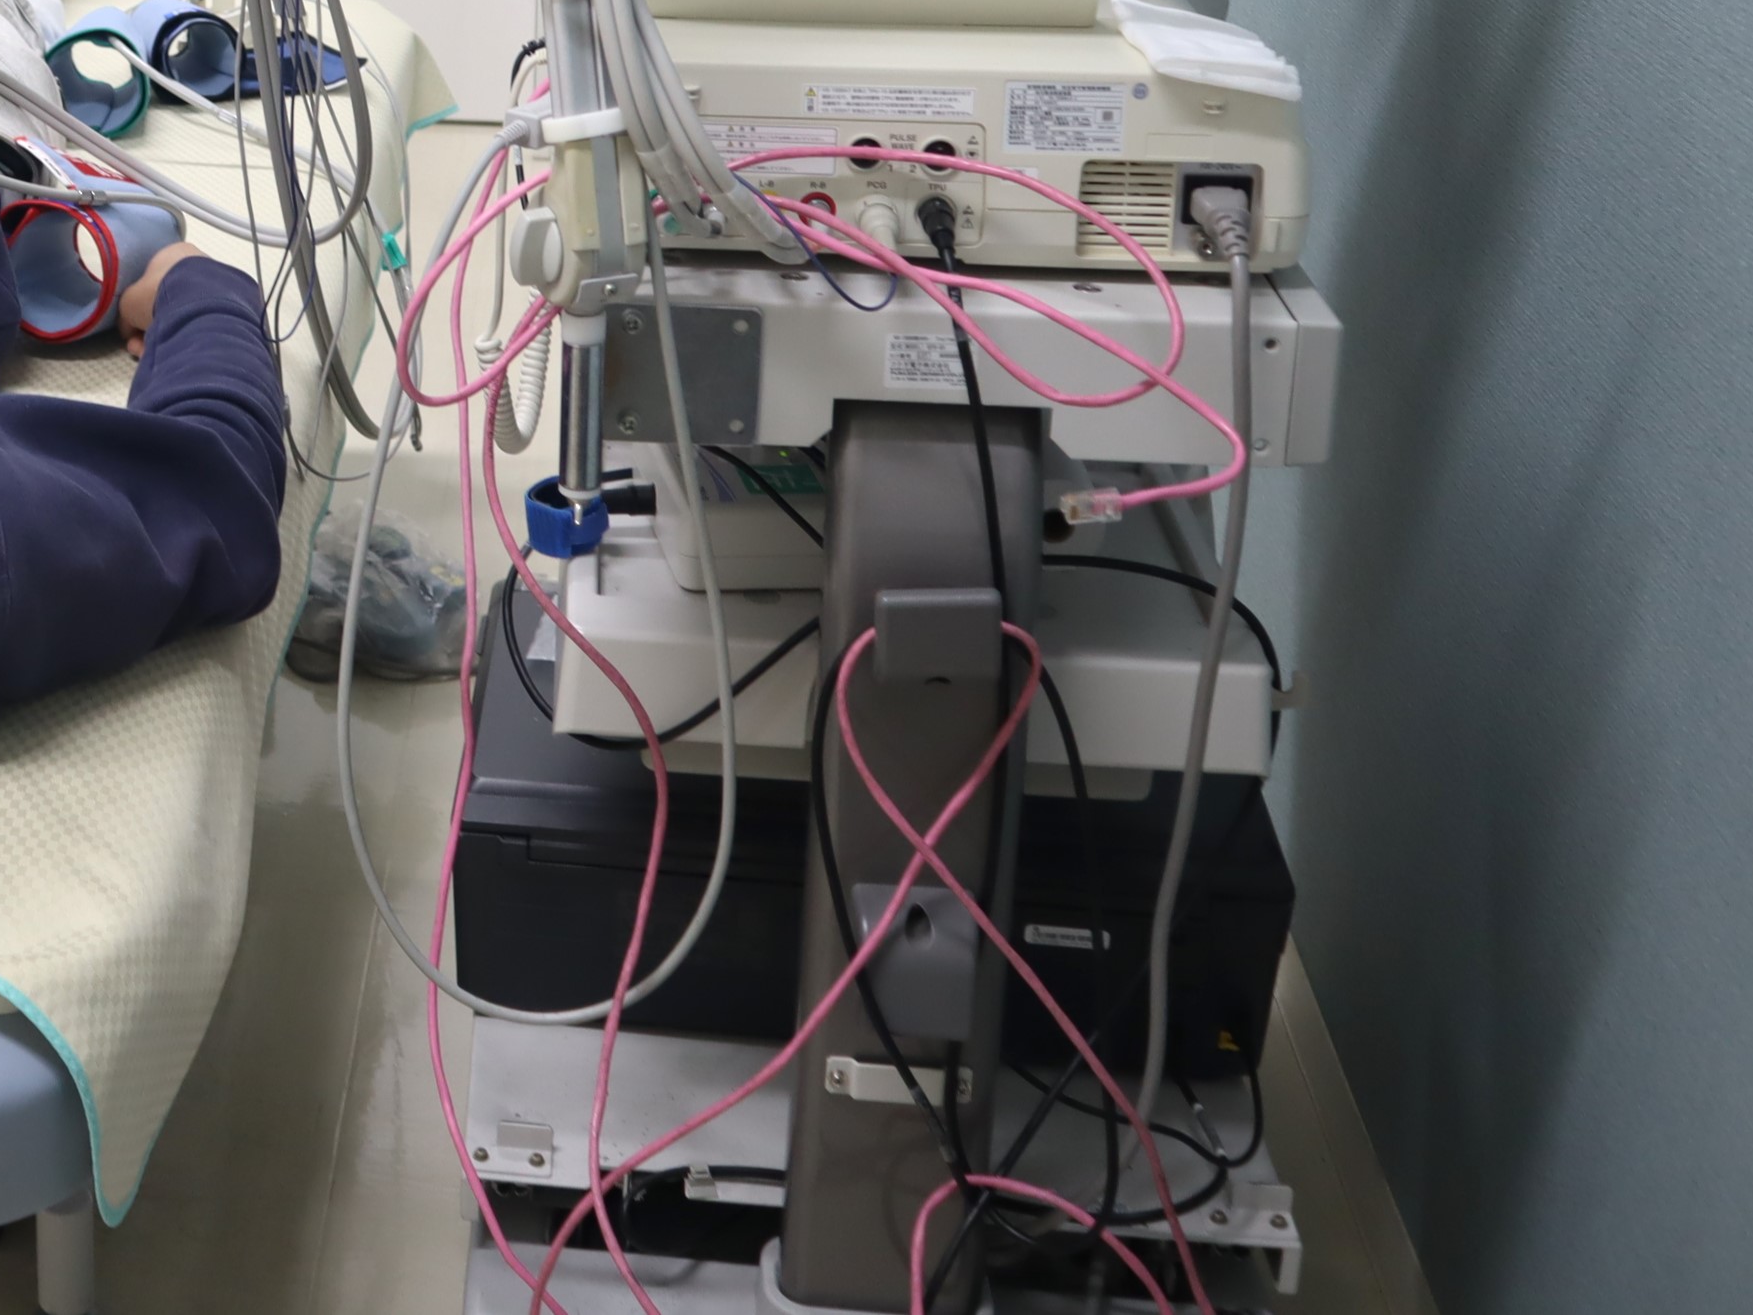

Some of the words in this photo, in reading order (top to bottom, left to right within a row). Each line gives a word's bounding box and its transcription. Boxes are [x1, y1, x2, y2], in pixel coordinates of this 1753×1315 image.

[889, 133, 917, 142] PULSE
[891, 142, 915, 151] WAVE
[888, 165, 894, 173] 1
[909, 165, 917, 173] 2
[810, 180, 827, 190] R-B
[866, 181, 887, 190] PCG
[928, 182, 946, 191] TPU
